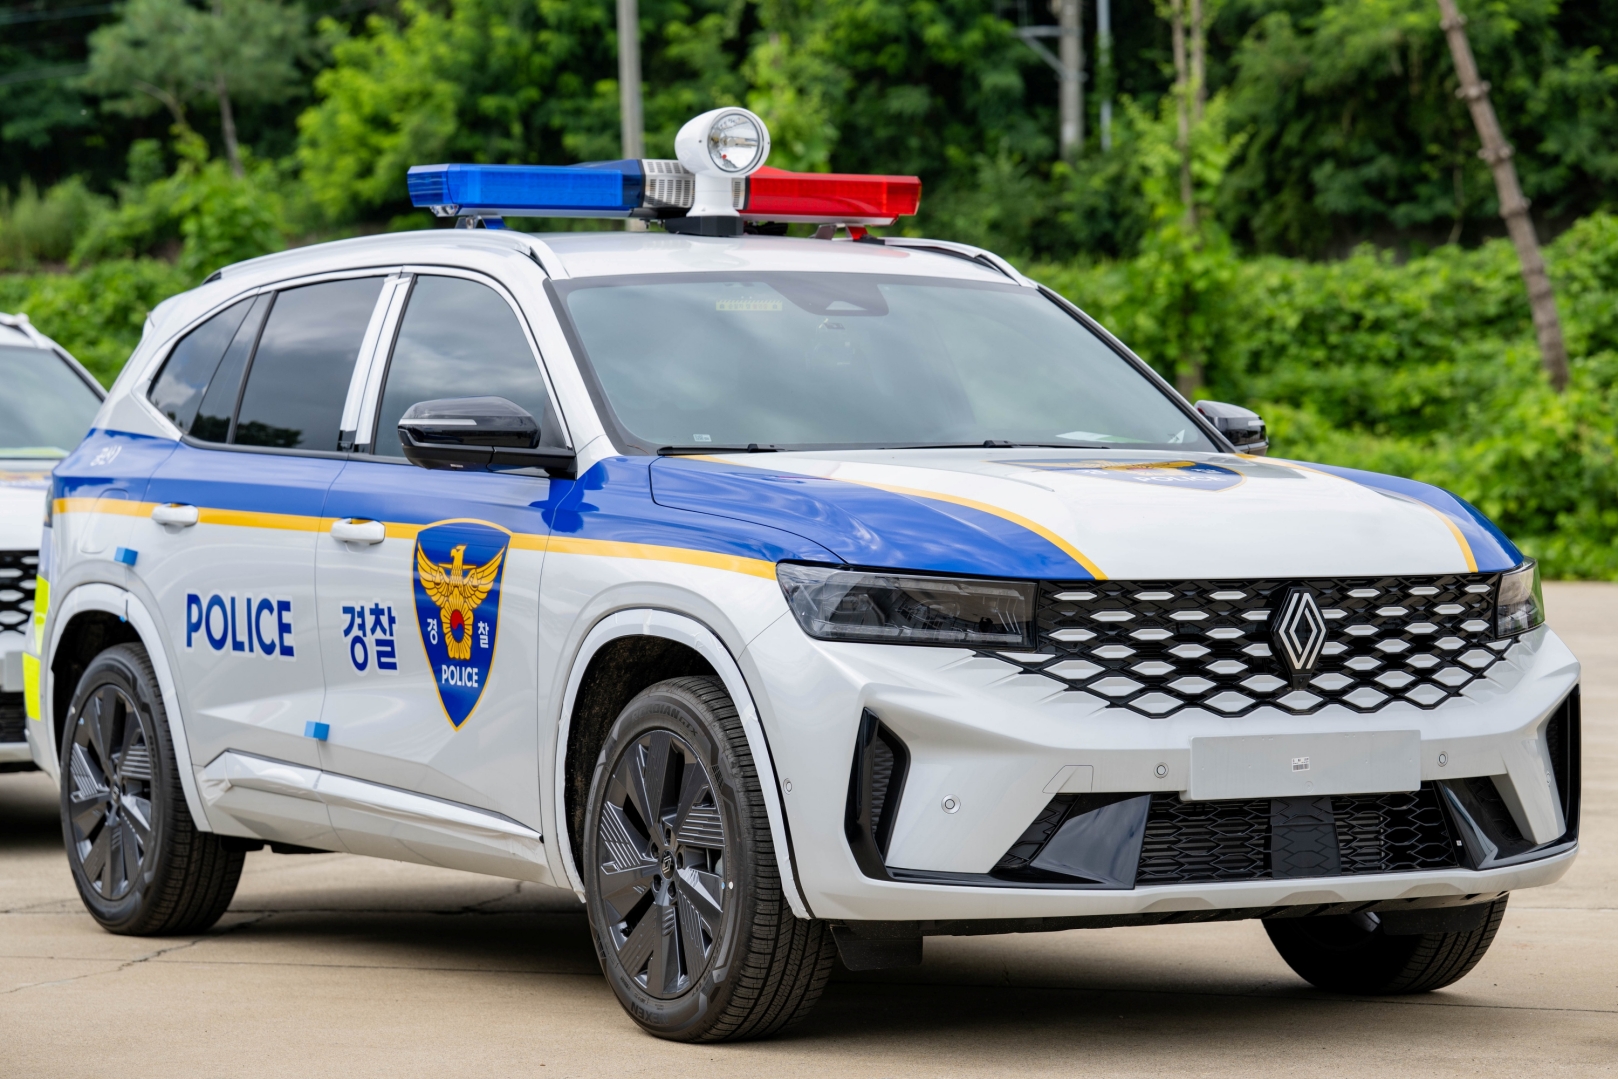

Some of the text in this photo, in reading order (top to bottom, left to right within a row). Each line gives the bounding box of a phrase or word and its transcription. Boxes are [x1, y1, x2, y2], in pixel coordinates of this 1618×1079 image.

[186, 593, 295, 657] POLICE
[342, 602, 398, 671] 경찰
[427, 618, 489, 648] 경 찰
[441, 664, 479, 688] POLICE
[631, 1001, 669, 1025] NEXEN
